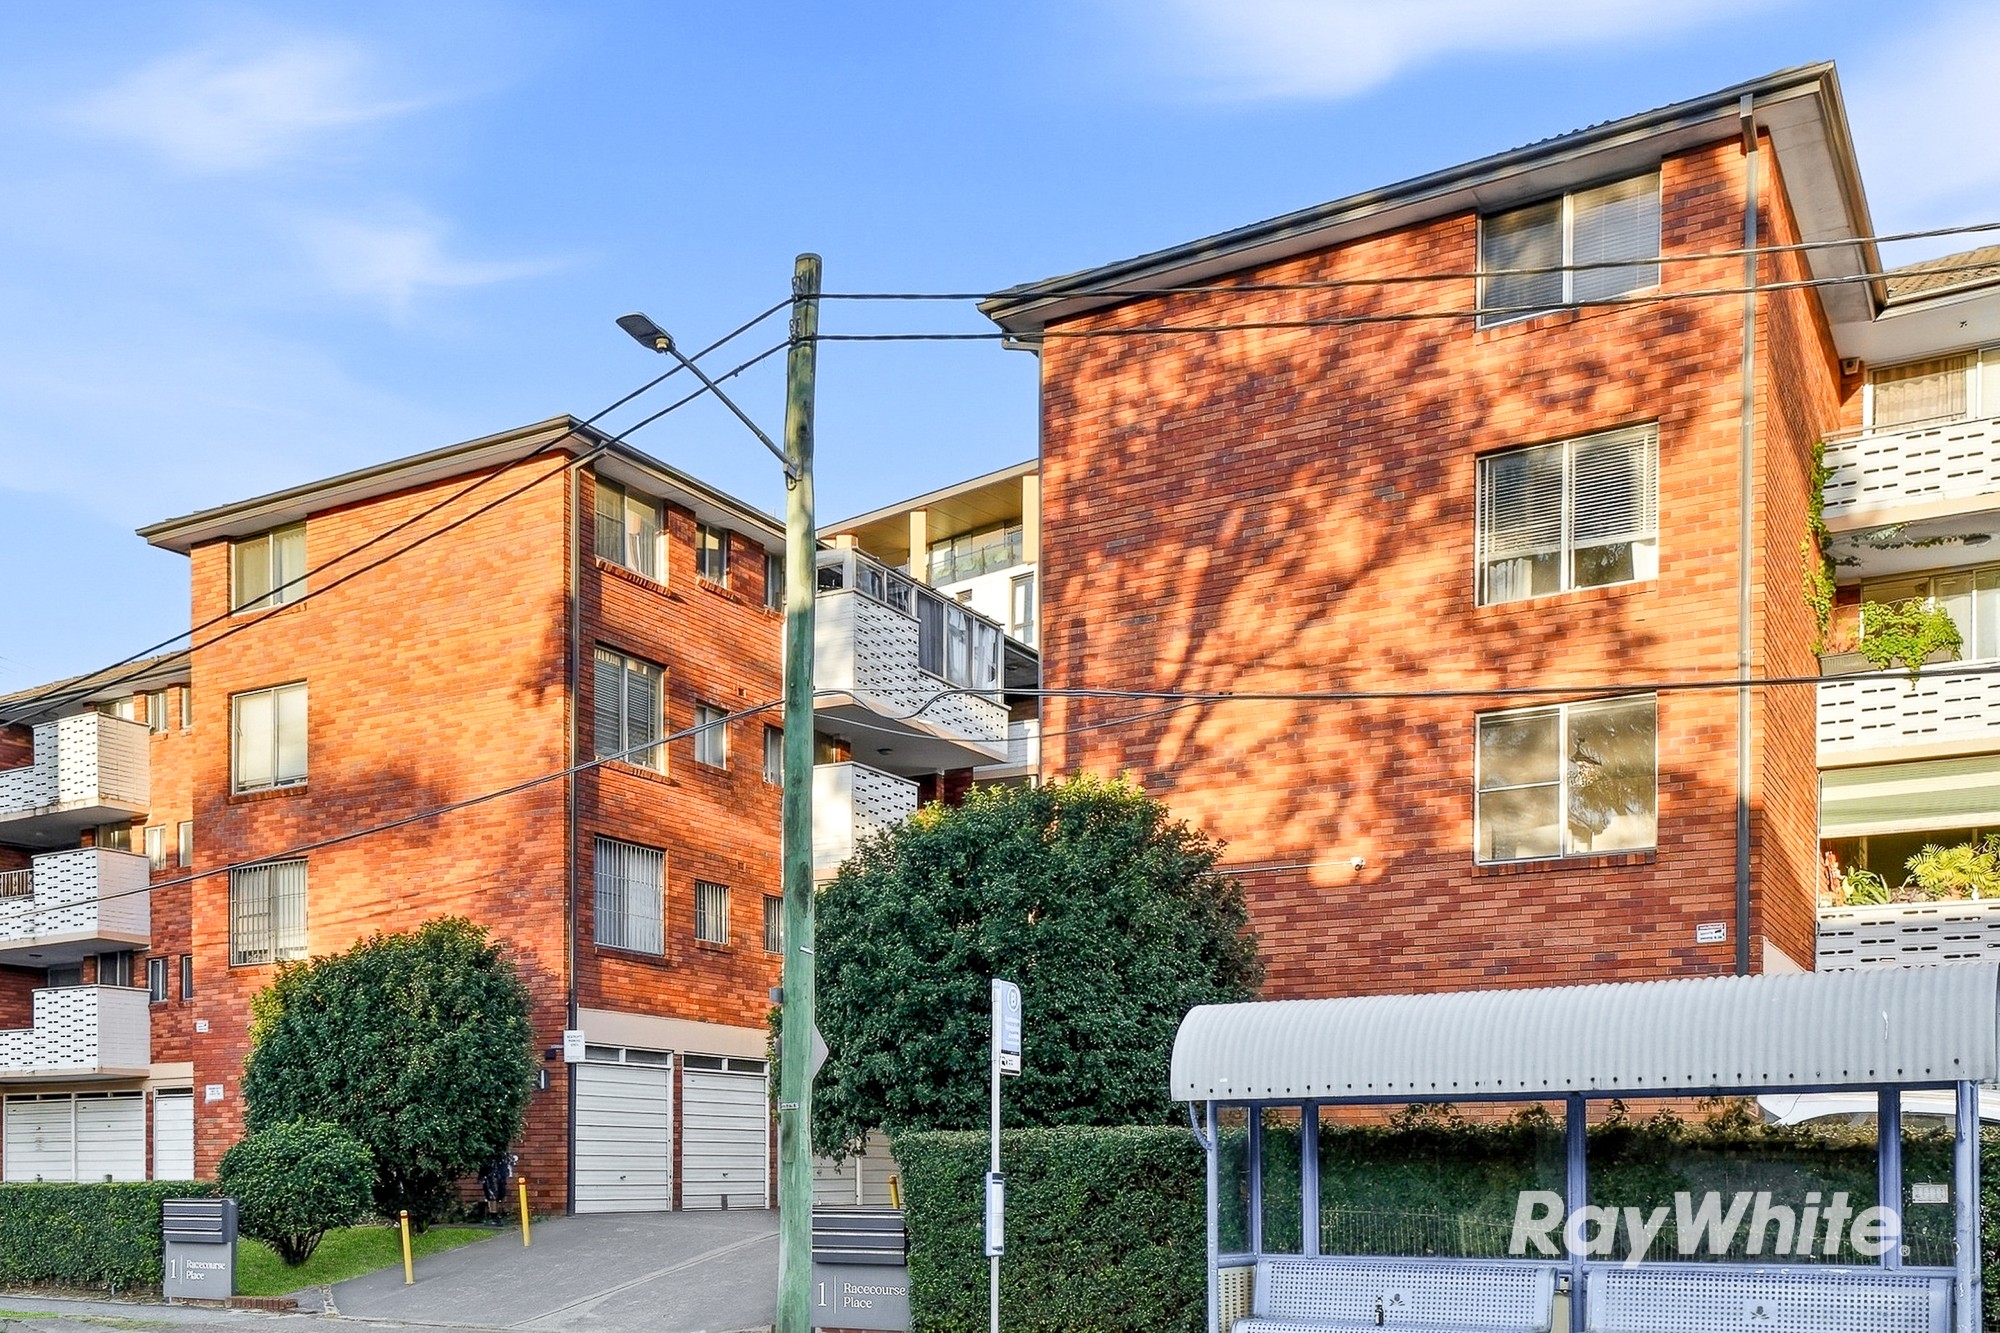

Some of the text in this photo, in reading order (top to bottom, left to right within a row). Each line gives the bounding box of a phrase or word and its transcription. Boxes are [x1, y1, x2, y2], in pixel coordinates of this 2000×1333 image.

[170, 1259, 226, 1279] 1 Racecourse
[186, 1270, 205, 1280] Place
[818, 1281, 906, 1307] 1 Racecourse
[843, 1296, 873, 1308] Place
